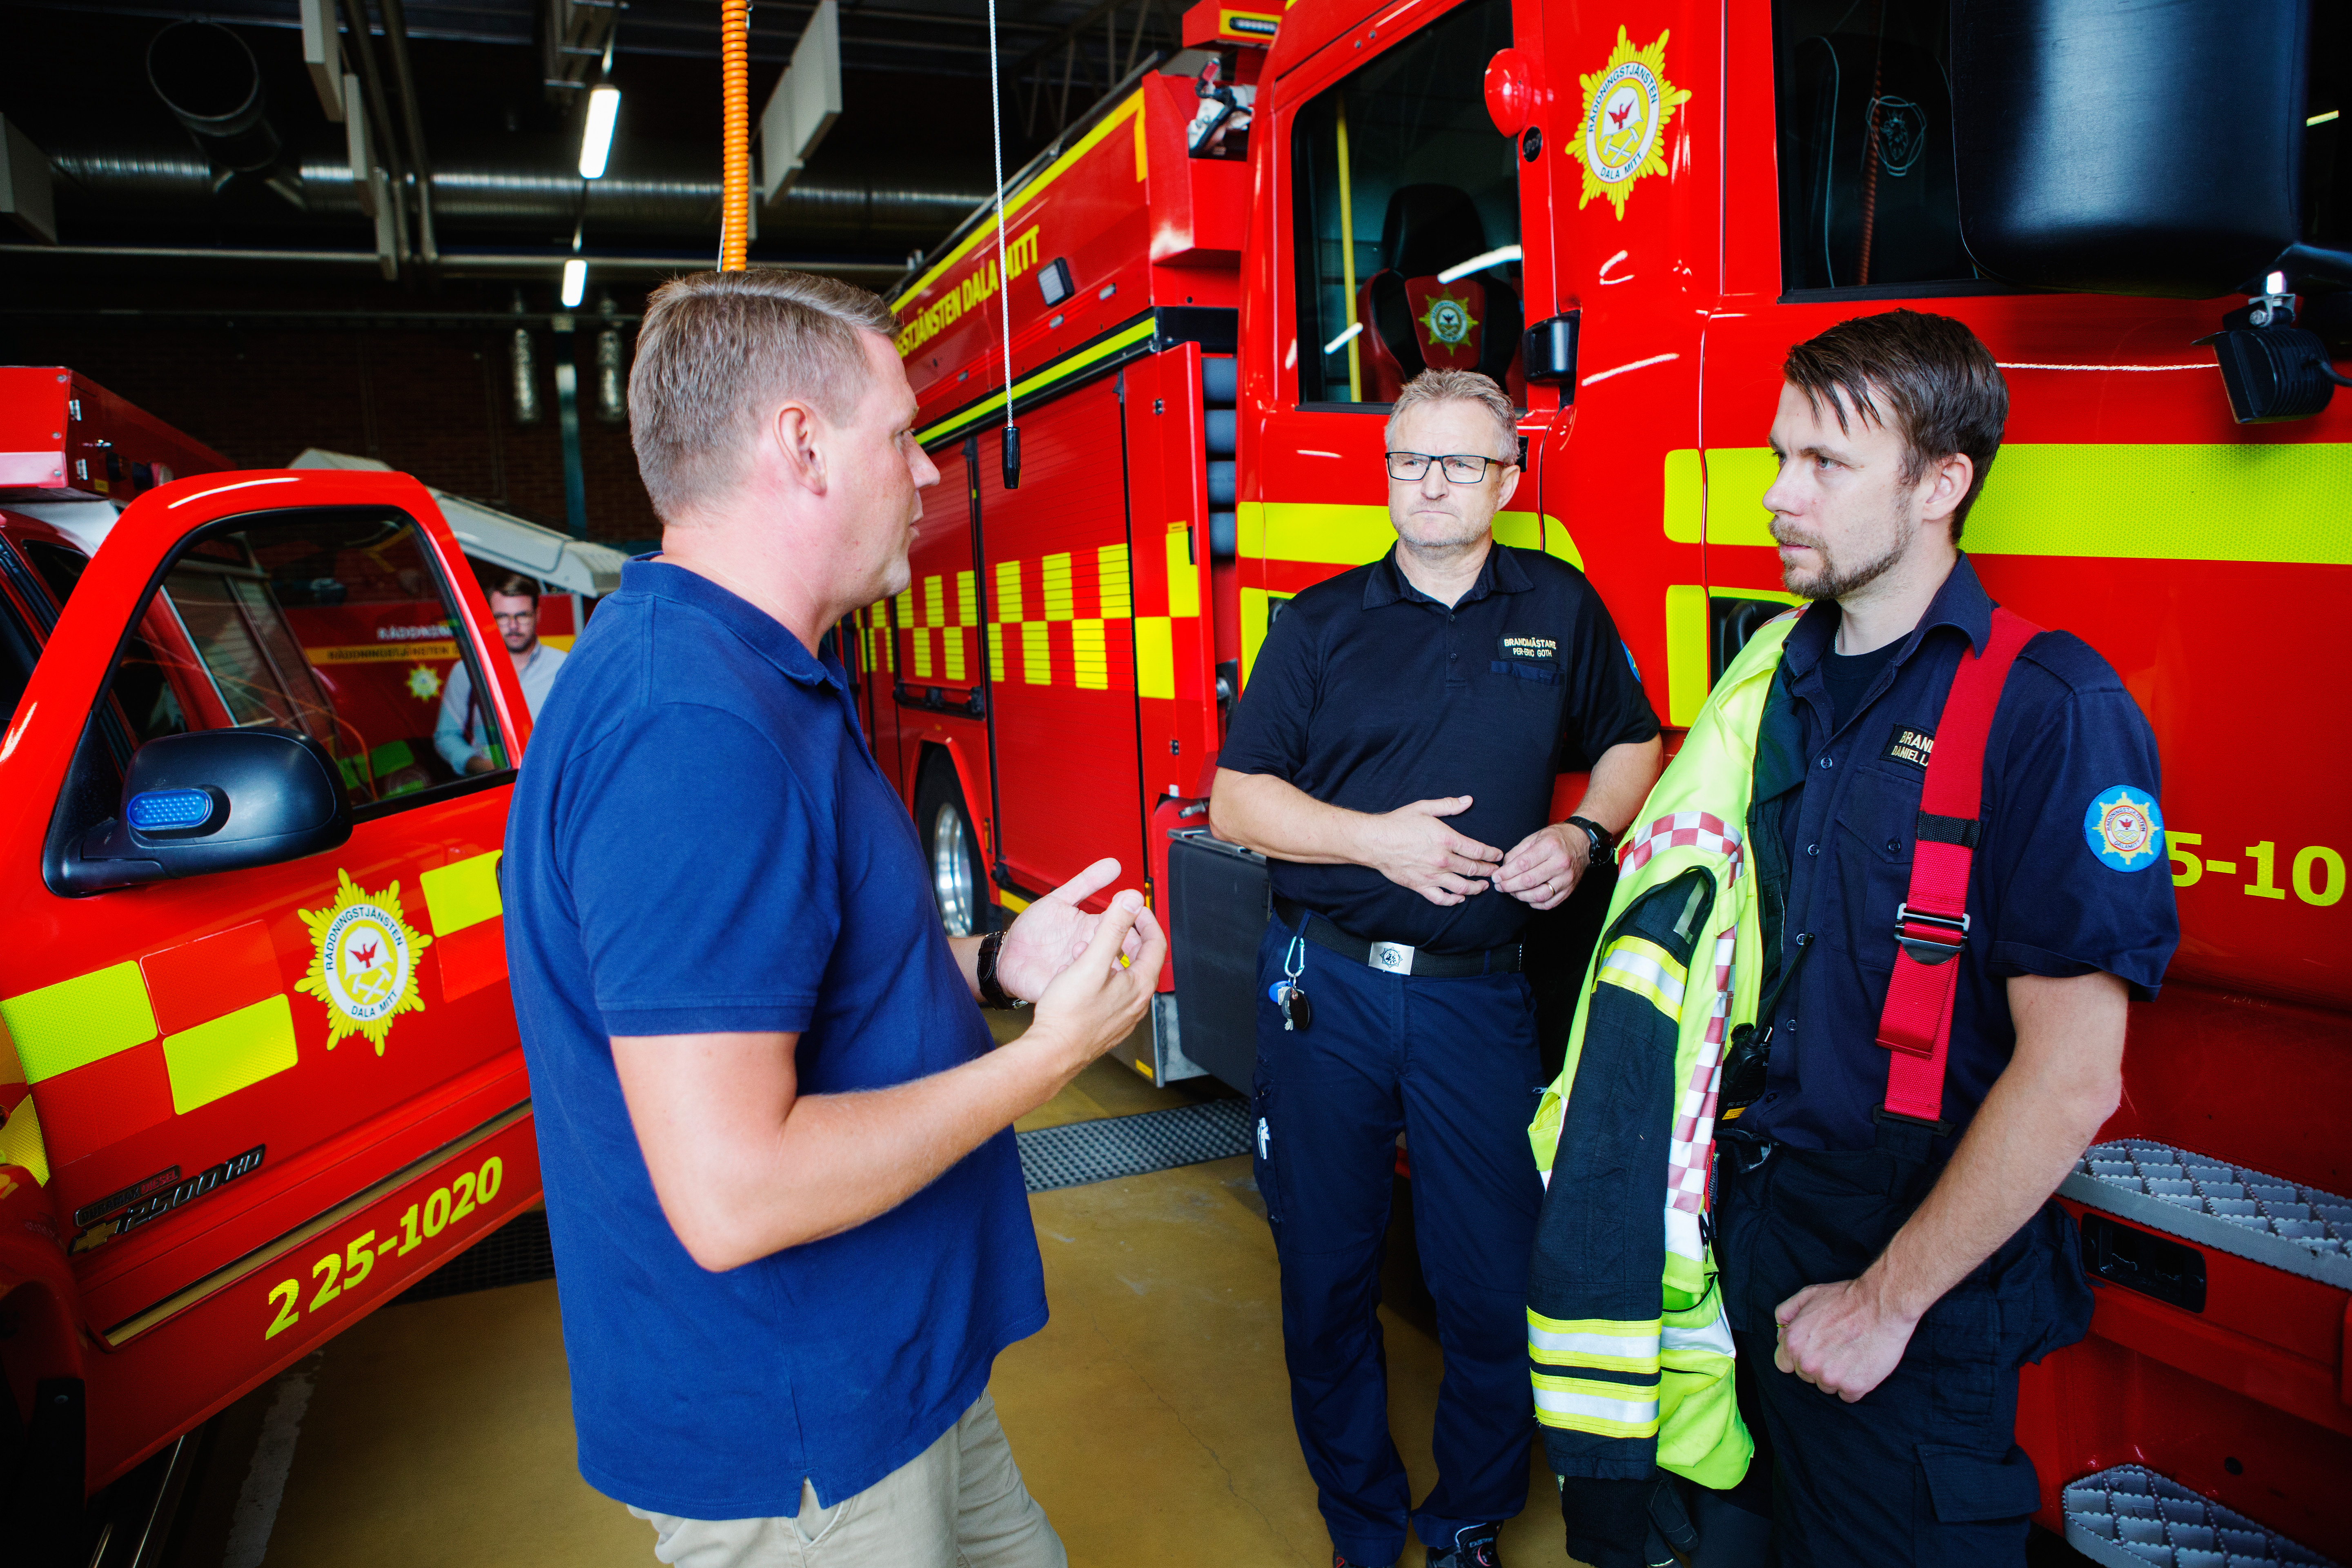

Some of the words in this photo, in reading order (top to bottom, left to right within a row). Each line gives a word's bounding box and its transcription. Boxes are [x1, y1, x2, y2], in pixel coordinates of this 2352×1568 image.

[1600, 166, 1620, 179] DALA
[1624, 151, 1642, 174] MITT
[961, 258, 1000, 312] DALA
[1504, 637, 1557, 650] BRANDMÄSTARE
[1891, 745, 1919, 763] DANIEL
[1919, 754, 1929, 767] L
[325, 906, 403, 970] RÄDDNINGSTJÄNSTEN
[352, 1005, 375, 1018] DALA
[380, 990, 397, 1011] MITT
[226, 1149, 263, 1180] HD
[140, 1170, 178, 1194] DIESEL
[265, 1278, 299, 1341] 2
[309, 1156, 503, 1313] 25-1020
